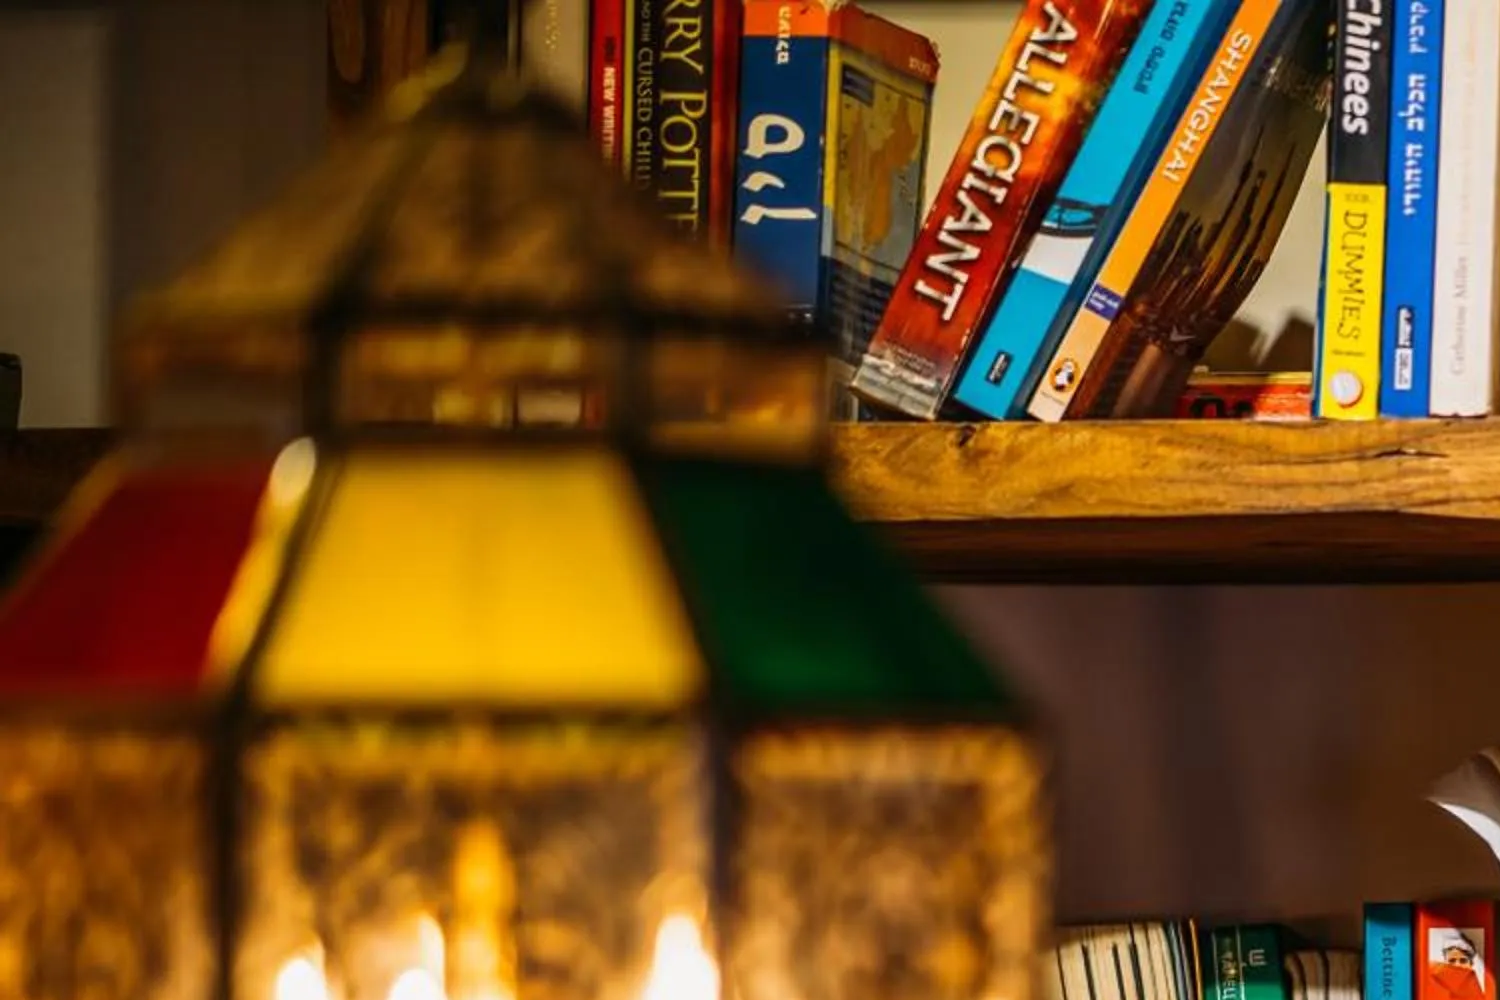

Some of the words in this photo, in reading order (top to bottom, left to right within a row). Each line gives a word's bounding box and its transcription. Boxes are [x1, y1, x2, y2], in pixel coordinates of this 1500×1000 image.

[636, 46, 652, 121] CURSED
[1159, 27, 1254, 183] SHANGHAI
[913, 2, 1079, 320] ALLEGIANT
[1335, 210, 1367, 340] DUMMIES
[1381, 936, 1397, 997] Bettine
